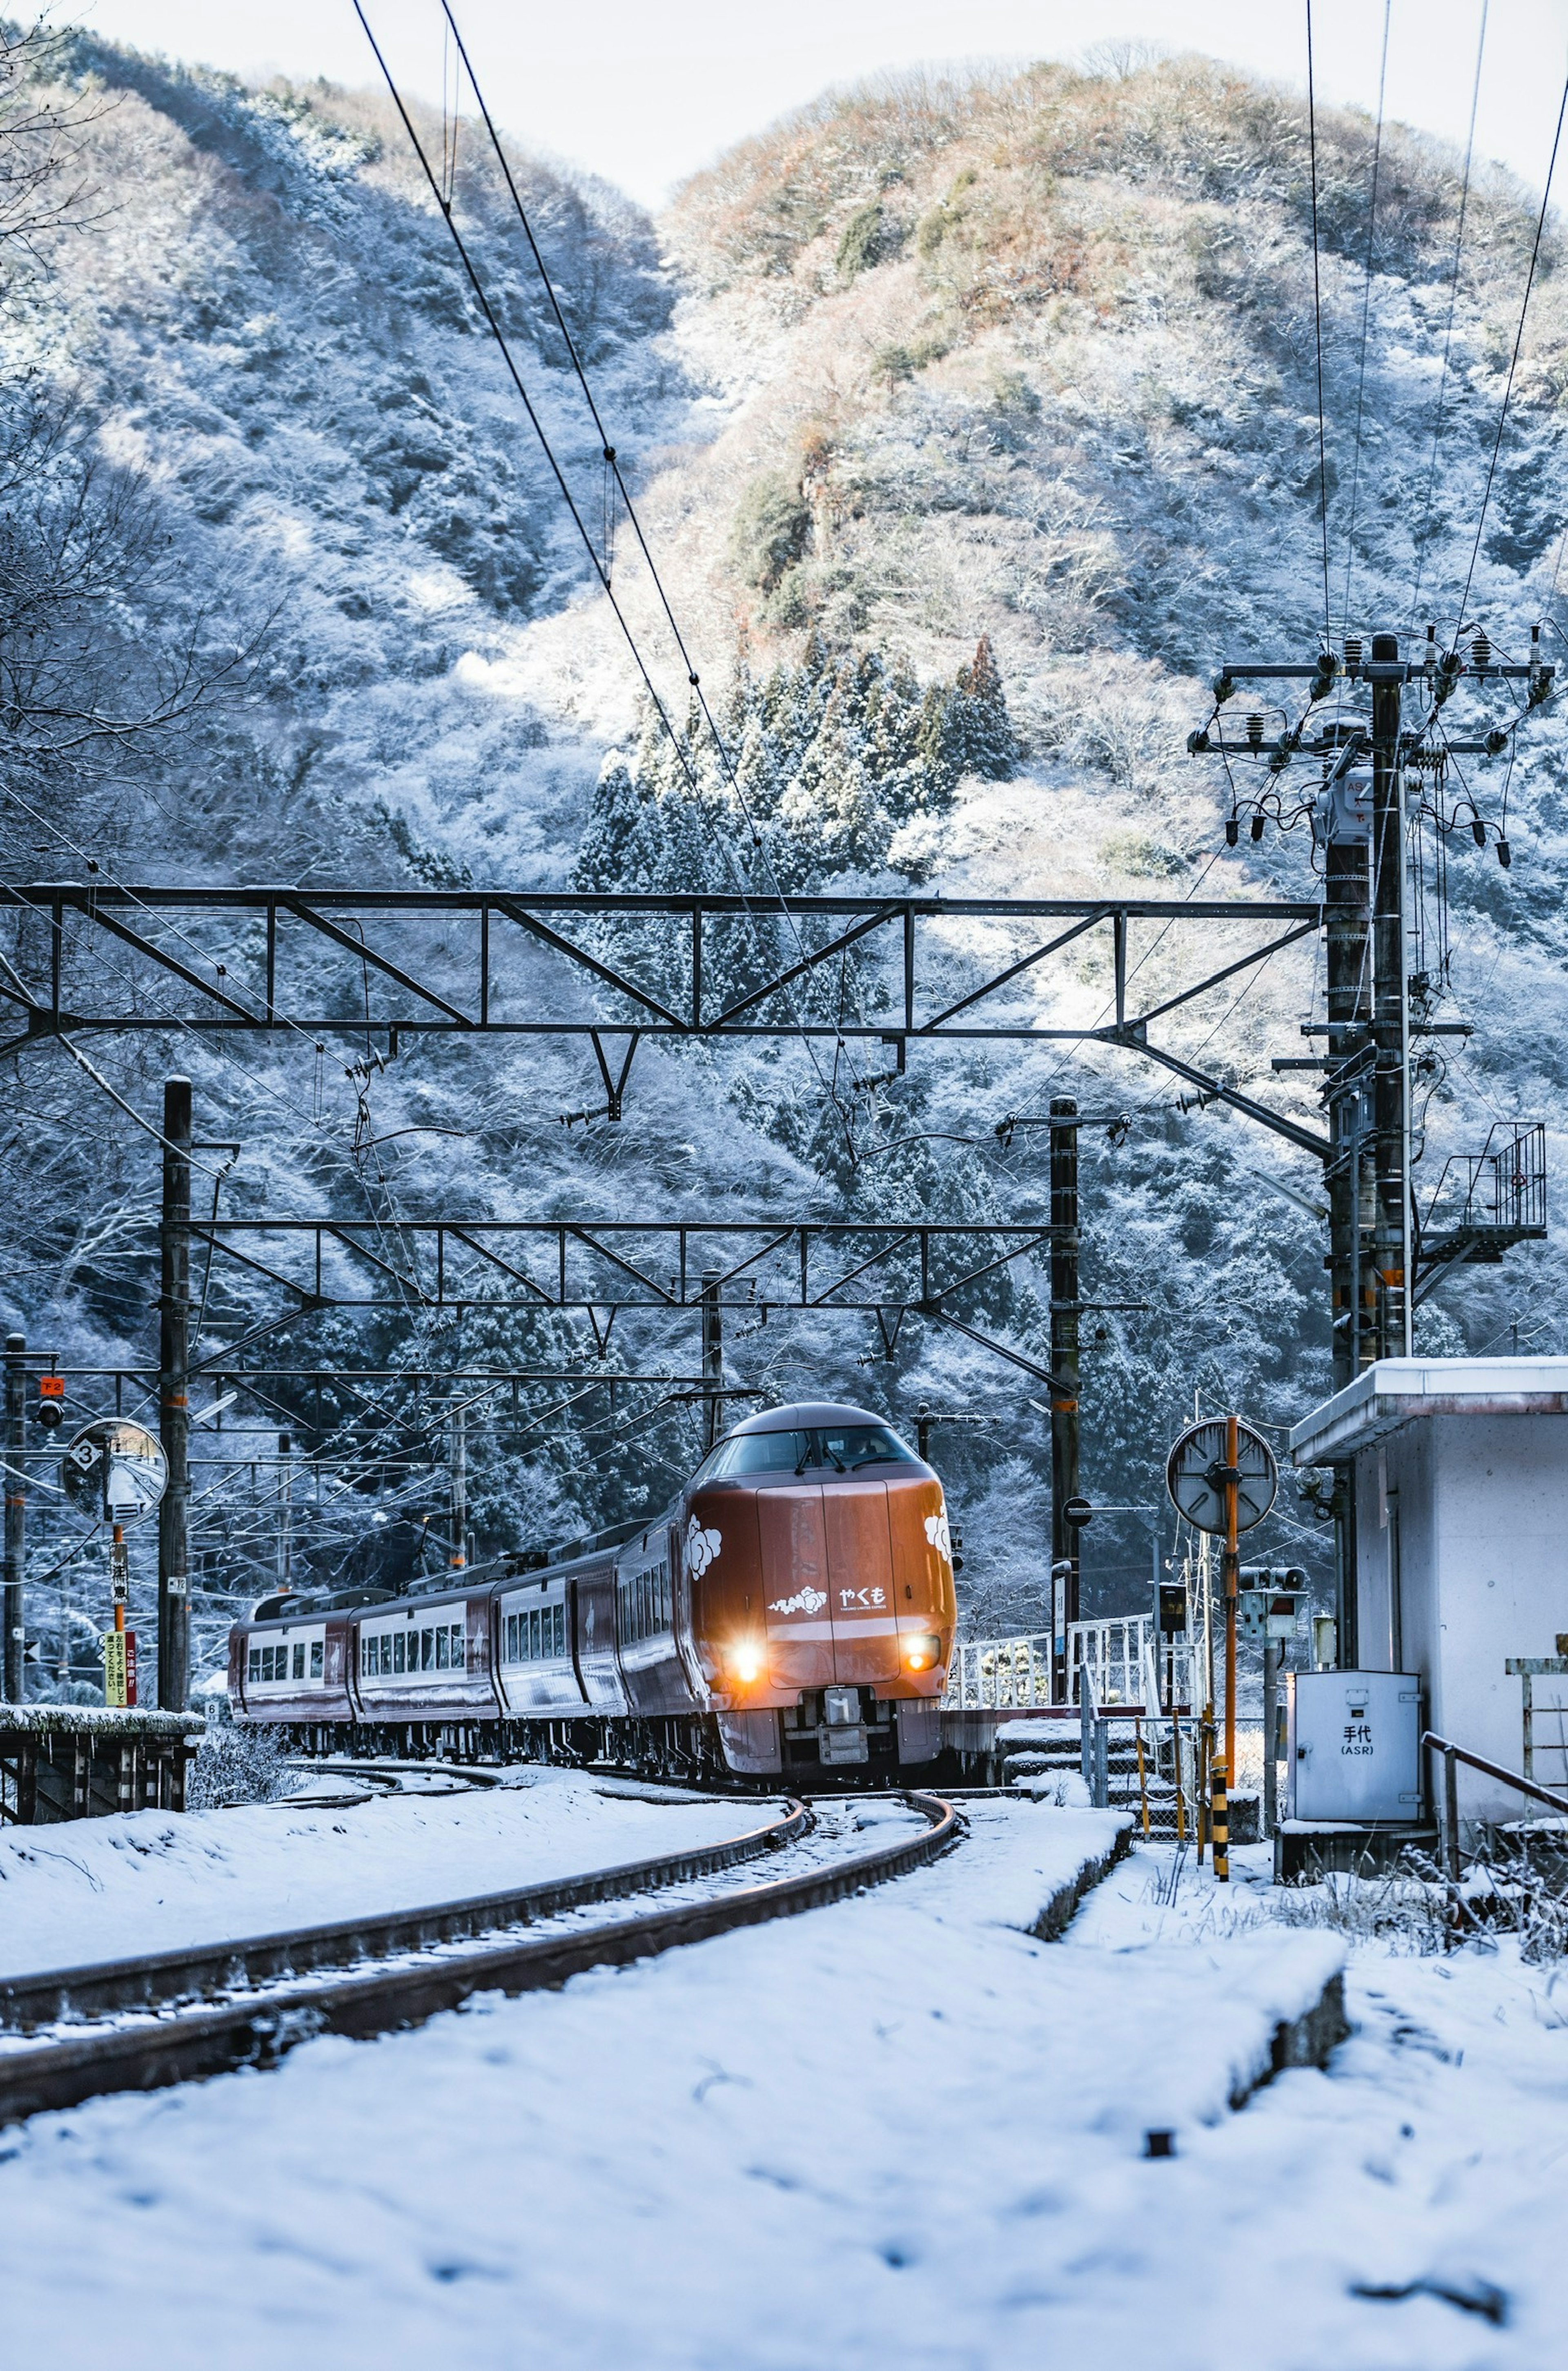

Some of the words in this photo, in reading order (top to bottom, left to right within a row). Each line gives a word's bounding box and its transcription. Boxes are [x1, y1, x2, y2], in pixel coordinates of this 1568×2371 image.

[1348, 783, 1363, 791] AS
[78, 1445, 92, 1464] 3
[840, 1587, 886, 1606] やくも
[107, 1635, 116, 1691] 渡ってください。
[209, 1704, 215, 1714] 6
[1343, 1725, 1371, 1743] 手代
[1341, 1746, 1374, 1755] (ASR)
